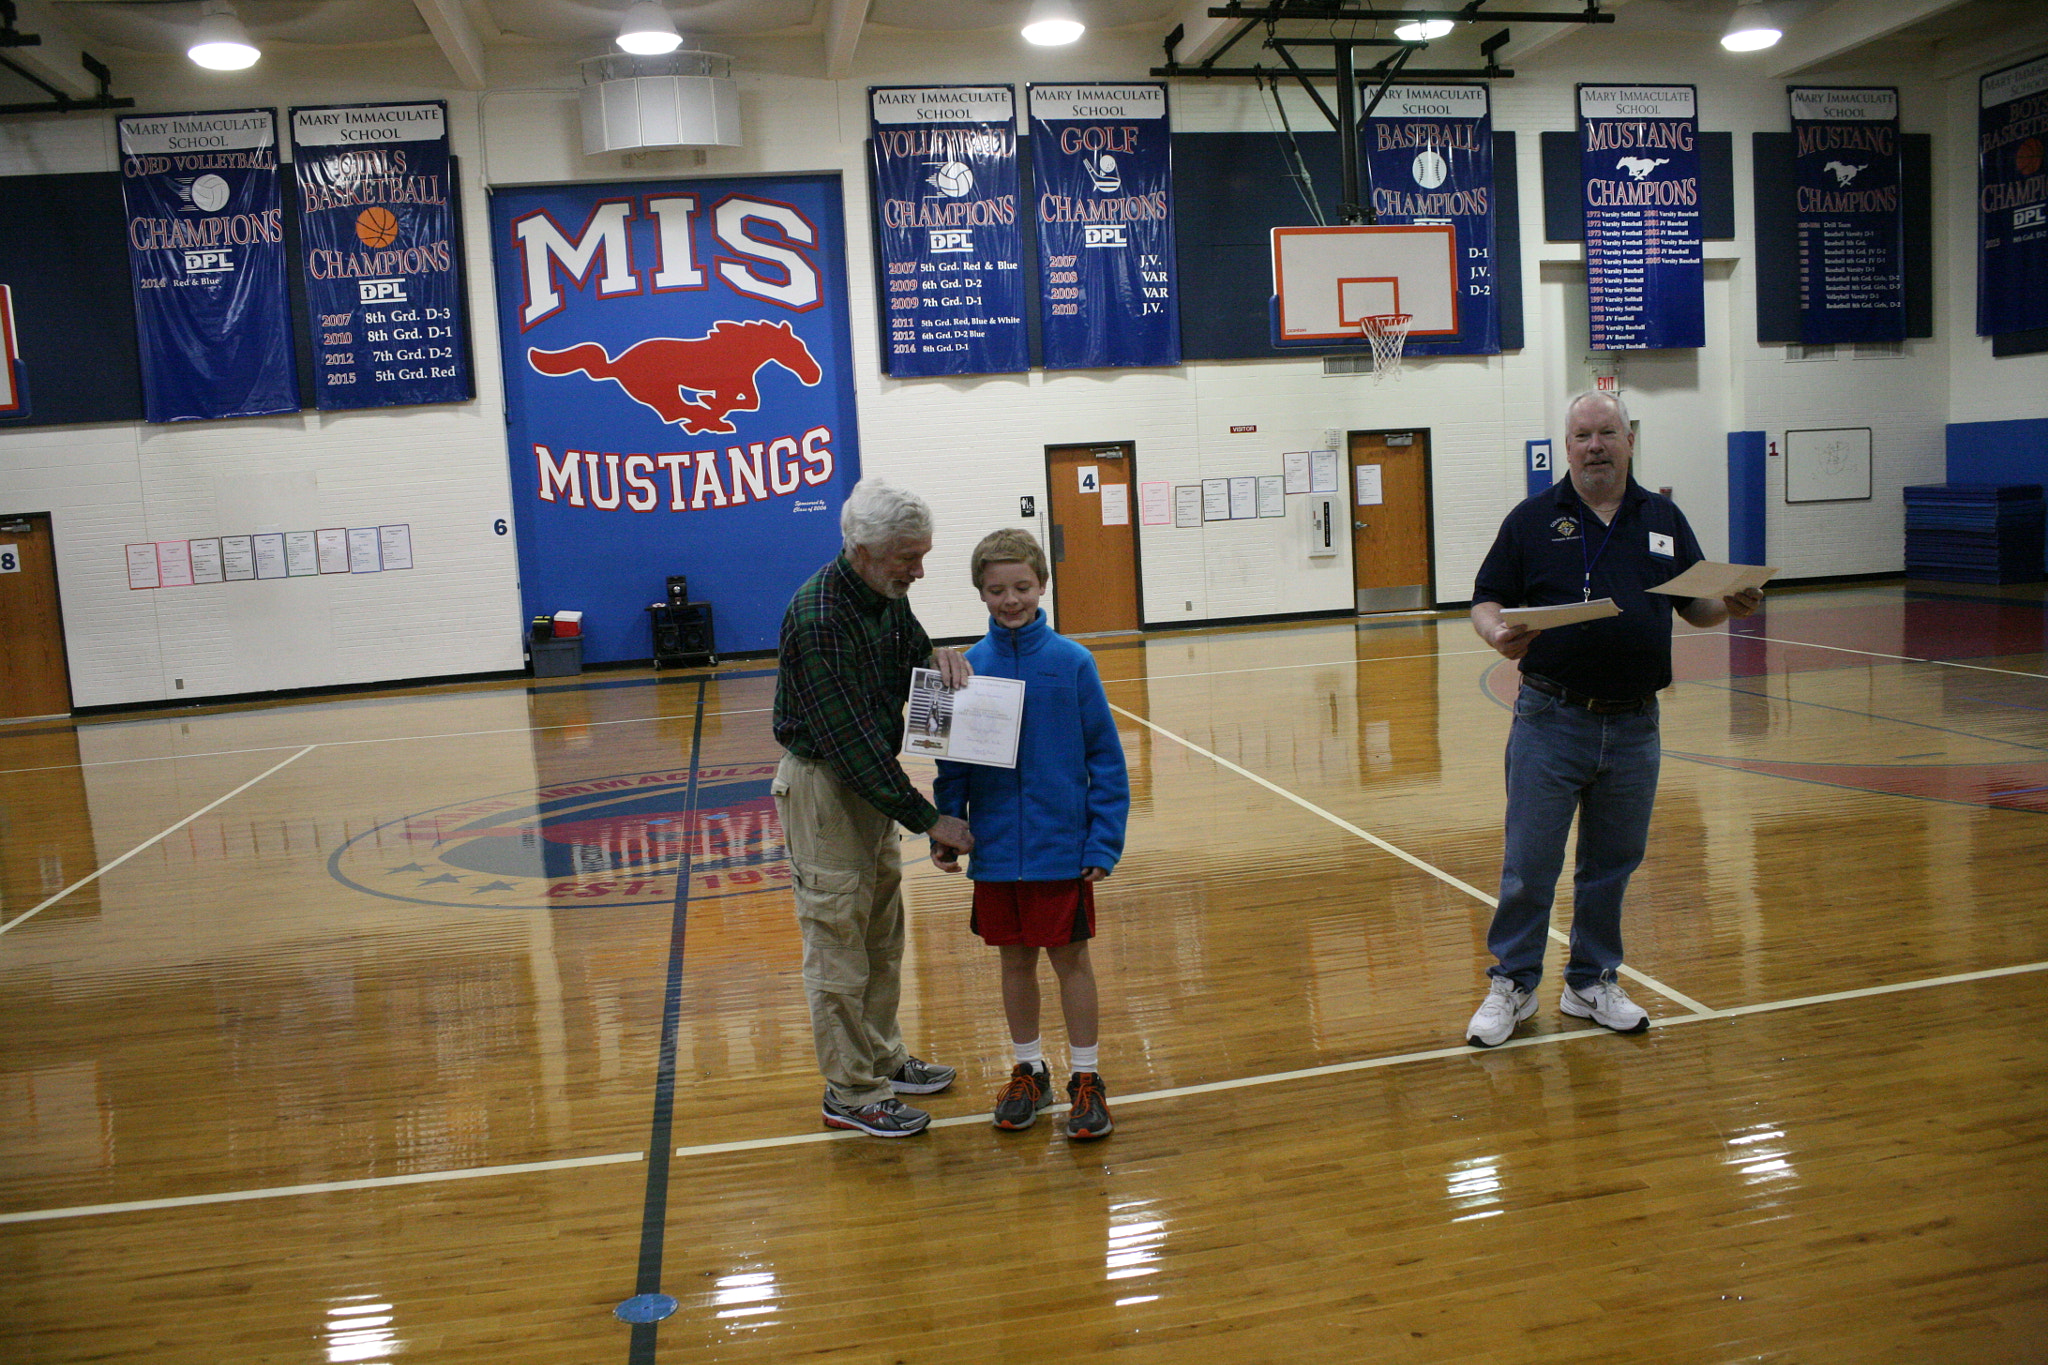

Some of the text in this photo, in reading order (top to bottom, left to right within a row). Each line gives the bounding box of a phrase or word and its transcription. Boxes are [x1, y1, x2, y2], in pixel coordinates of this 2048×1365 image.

[879, 91, 1007, 104] MARY IMMACULATE
[1035, 89, 1161, 100] MARY IMMACULATE
[1407, 89, 1482, 99] IMMACULATE
[1585, 91, 1690, 101] MARY IMMACULATE
[917, 109, 972, 120] SCHOOL
[1072, 105, 1126, 116] SCHOOL
[1402, 104, 1452, 114] SCHOOL
[1616, 104, 1660, 114] SCHOOL
[1824, 107, 1866, 117] SCHOOL
[300, 109, 439, 126] MARY IMMACULATE
[126, 118, 267, 136] MARY IMMACULATE
[340, 129, 401, 140] SCHOOL
[169, 135, 228, 149] SCHOOL
[1061, 127, 1138, 154] GOLF
[1376, 123, 1480, 152] BASEBALL
[1586, 122, 1693, 152] MUSTANG
[1796, 126, 1893, 158] MUSTANG
[124, 151, 277, 177] COED VOLLEYBALL
[305, 176, 446, 213] BASKETBALL
[1587, 178, 1697, 206] CHAMPIONS
[1797, 185, 1897, 212] CHAMPIONS
[1041, 191, 1167, 222] CHAMPIONS
[1373, 187, 1487, 216] CHAMPIONS
[885, 195, 1015, 228] CHAMPIONS
[2013, 208, 2046, 225] DPL
[131, 209, 283, 250] CHAMPIONS
[1085, 229, 1126, 244] DPL
[930, 234, 973, 248] DPL
[310, 241, 450, 279] CHAMPIONS
[1469, 248, 1488, 258] D-1
[185, 253, 234, 270] DPL
[511, 191, 824, 335] MIS
[889, 262, 917, 274] 2007
[921, 264, 935, 272] 5th
[939, 263, 960, 271] Grd.
[964, 262, 980, 270] Red
[998, 261, 1018, 269] Blue
[1140, 255, 1162, 268] J.V.
[1143, 272, 1168, 282] VAR
[1471, 267, 1490, 277] J.V.
[141, 279, 166, 288] 2014
[173, 279, 190, 287] Red
[201, 277, 220, 285] Blue
[922, 281, 937, 289] 6th
[941, 280, 961, 288] Grd.
[965, 279, 982, 287] D-2
[1470, 285, 1490, 295] D-2
[359, 282, 406, 300] DPL
[1143, 288, 1168, 298] VAR
[923, 299, 938, 307] 7th
[941, 298, 962, 306] Grd.
[966, 297, 982, 305] D-1
[1143, 303, 1163, 315] J.V.
[322, 309, 451, 326] 2007 8th Grd. D-3
[892, 318, 914, 328] 2011
[368, 330, 388, 342] 8th
[393, 329, 422, 340] Grd.
[428, 327, 452, 338] D-1
[893, 331, 915, 341] 2012
[326, 347, 452, 365] 2012 7th Grd. D-2
[328, 366, 456, 385] 2015 5th Grd. Red
[1598, 377, 1614, 390] EXIT
[1769, 442, 1779, 456] 1
[1536, 453, 1546, 468] 2
[534, 425, 833, 514] MUSTANGS
[1083, 474, 1095, 490] 4
[494, 519, 507, 536] 6
[1, 553, 15, 570] 8
